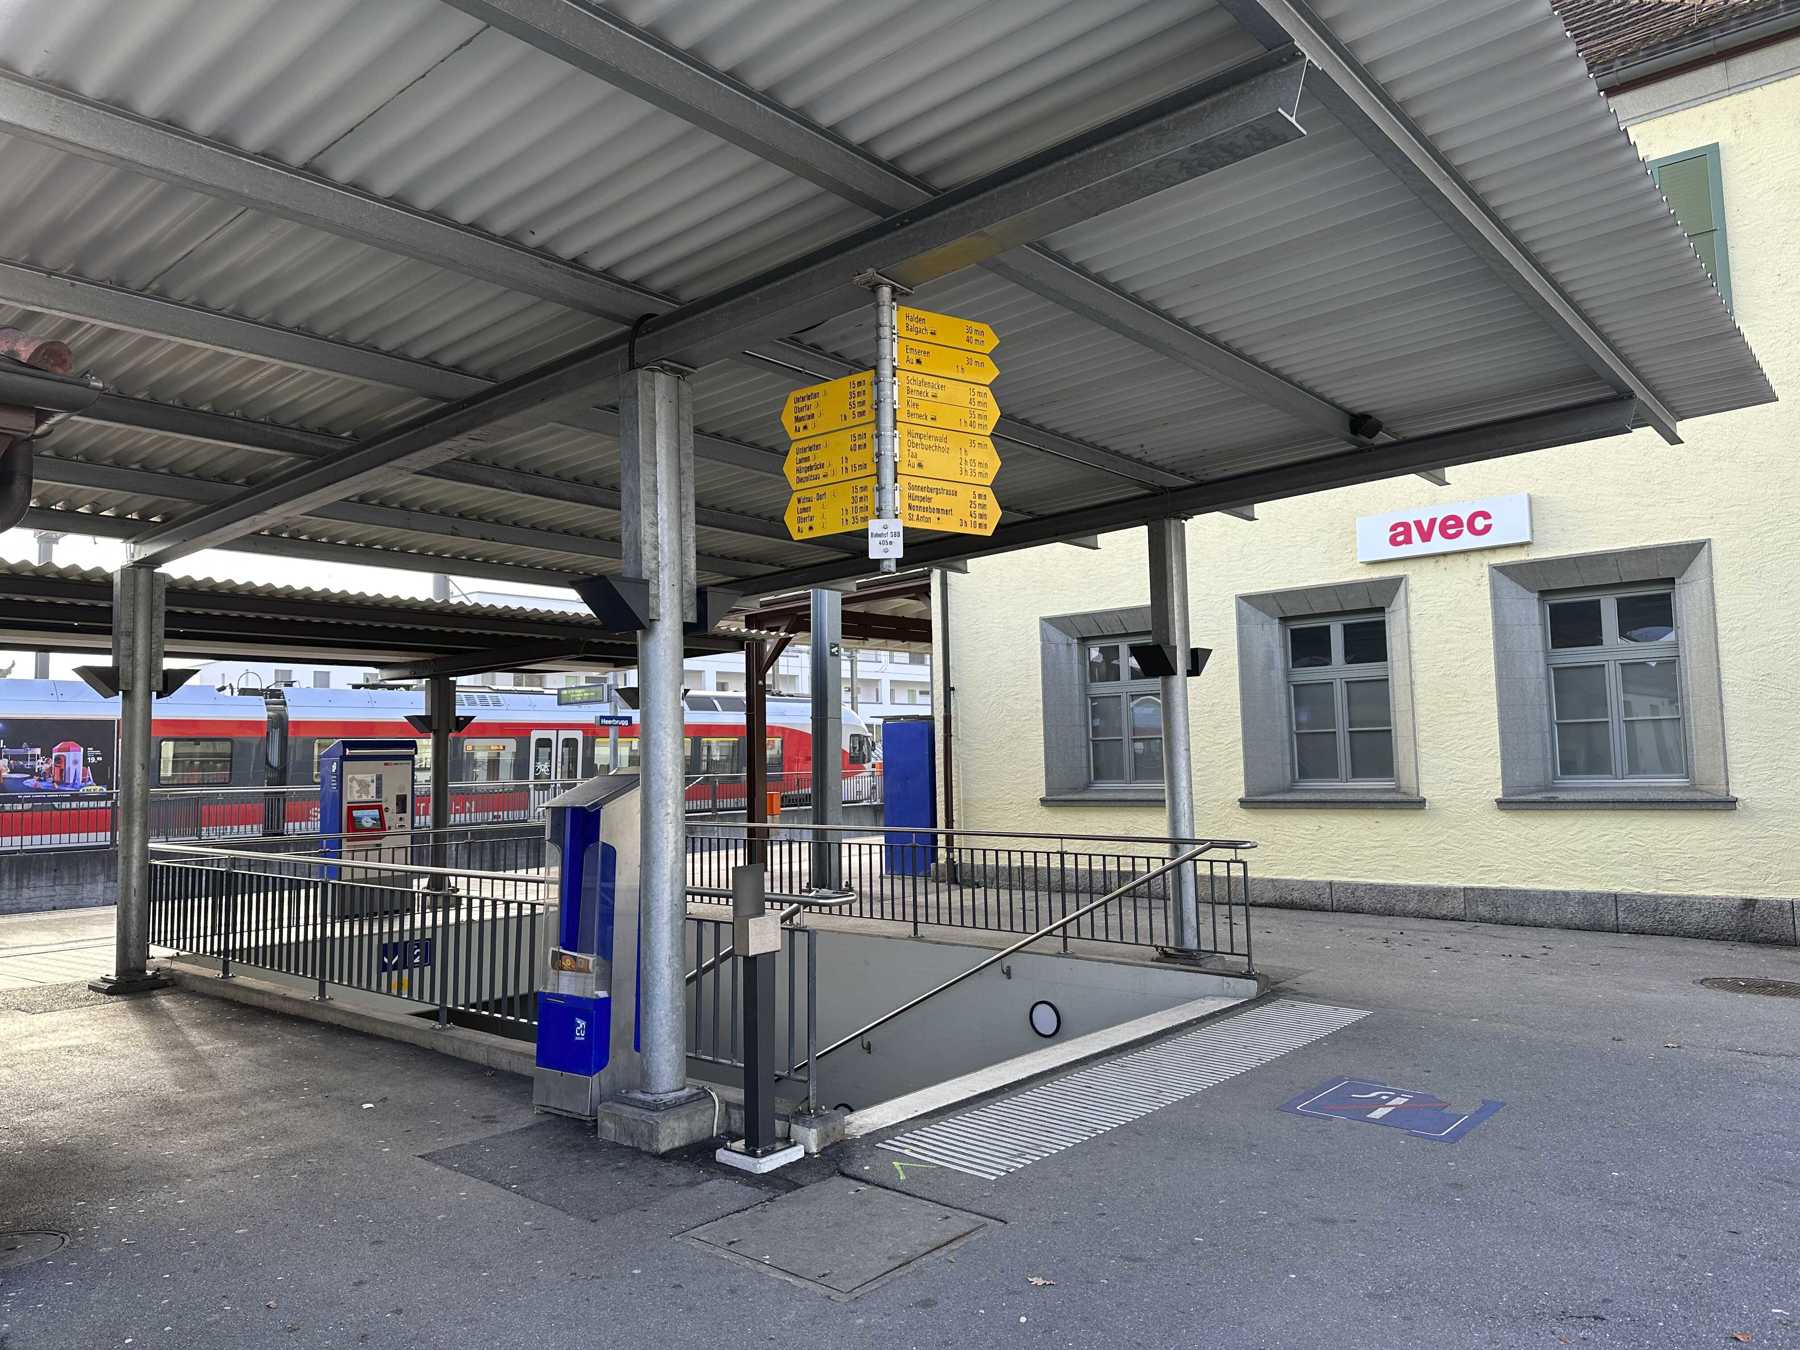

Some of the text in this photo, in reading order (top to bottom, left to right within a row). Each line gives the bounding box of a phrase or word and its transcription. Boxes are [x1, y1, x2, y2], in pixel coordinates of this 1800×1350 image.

[906, 313, 926, 324] Halden
[906, 322, 928, 335] Balgach
[906, 386, 928, 398] Berneck
[969, 388, 976, 396] 15
[906, 410, 928, 420] Berneck
[969, 440, 976, 448] 35
[970, 468, 976, 477] 35
[1388, 510, 1493, 547] avec
[576, 1020, 586, 1037] 20
